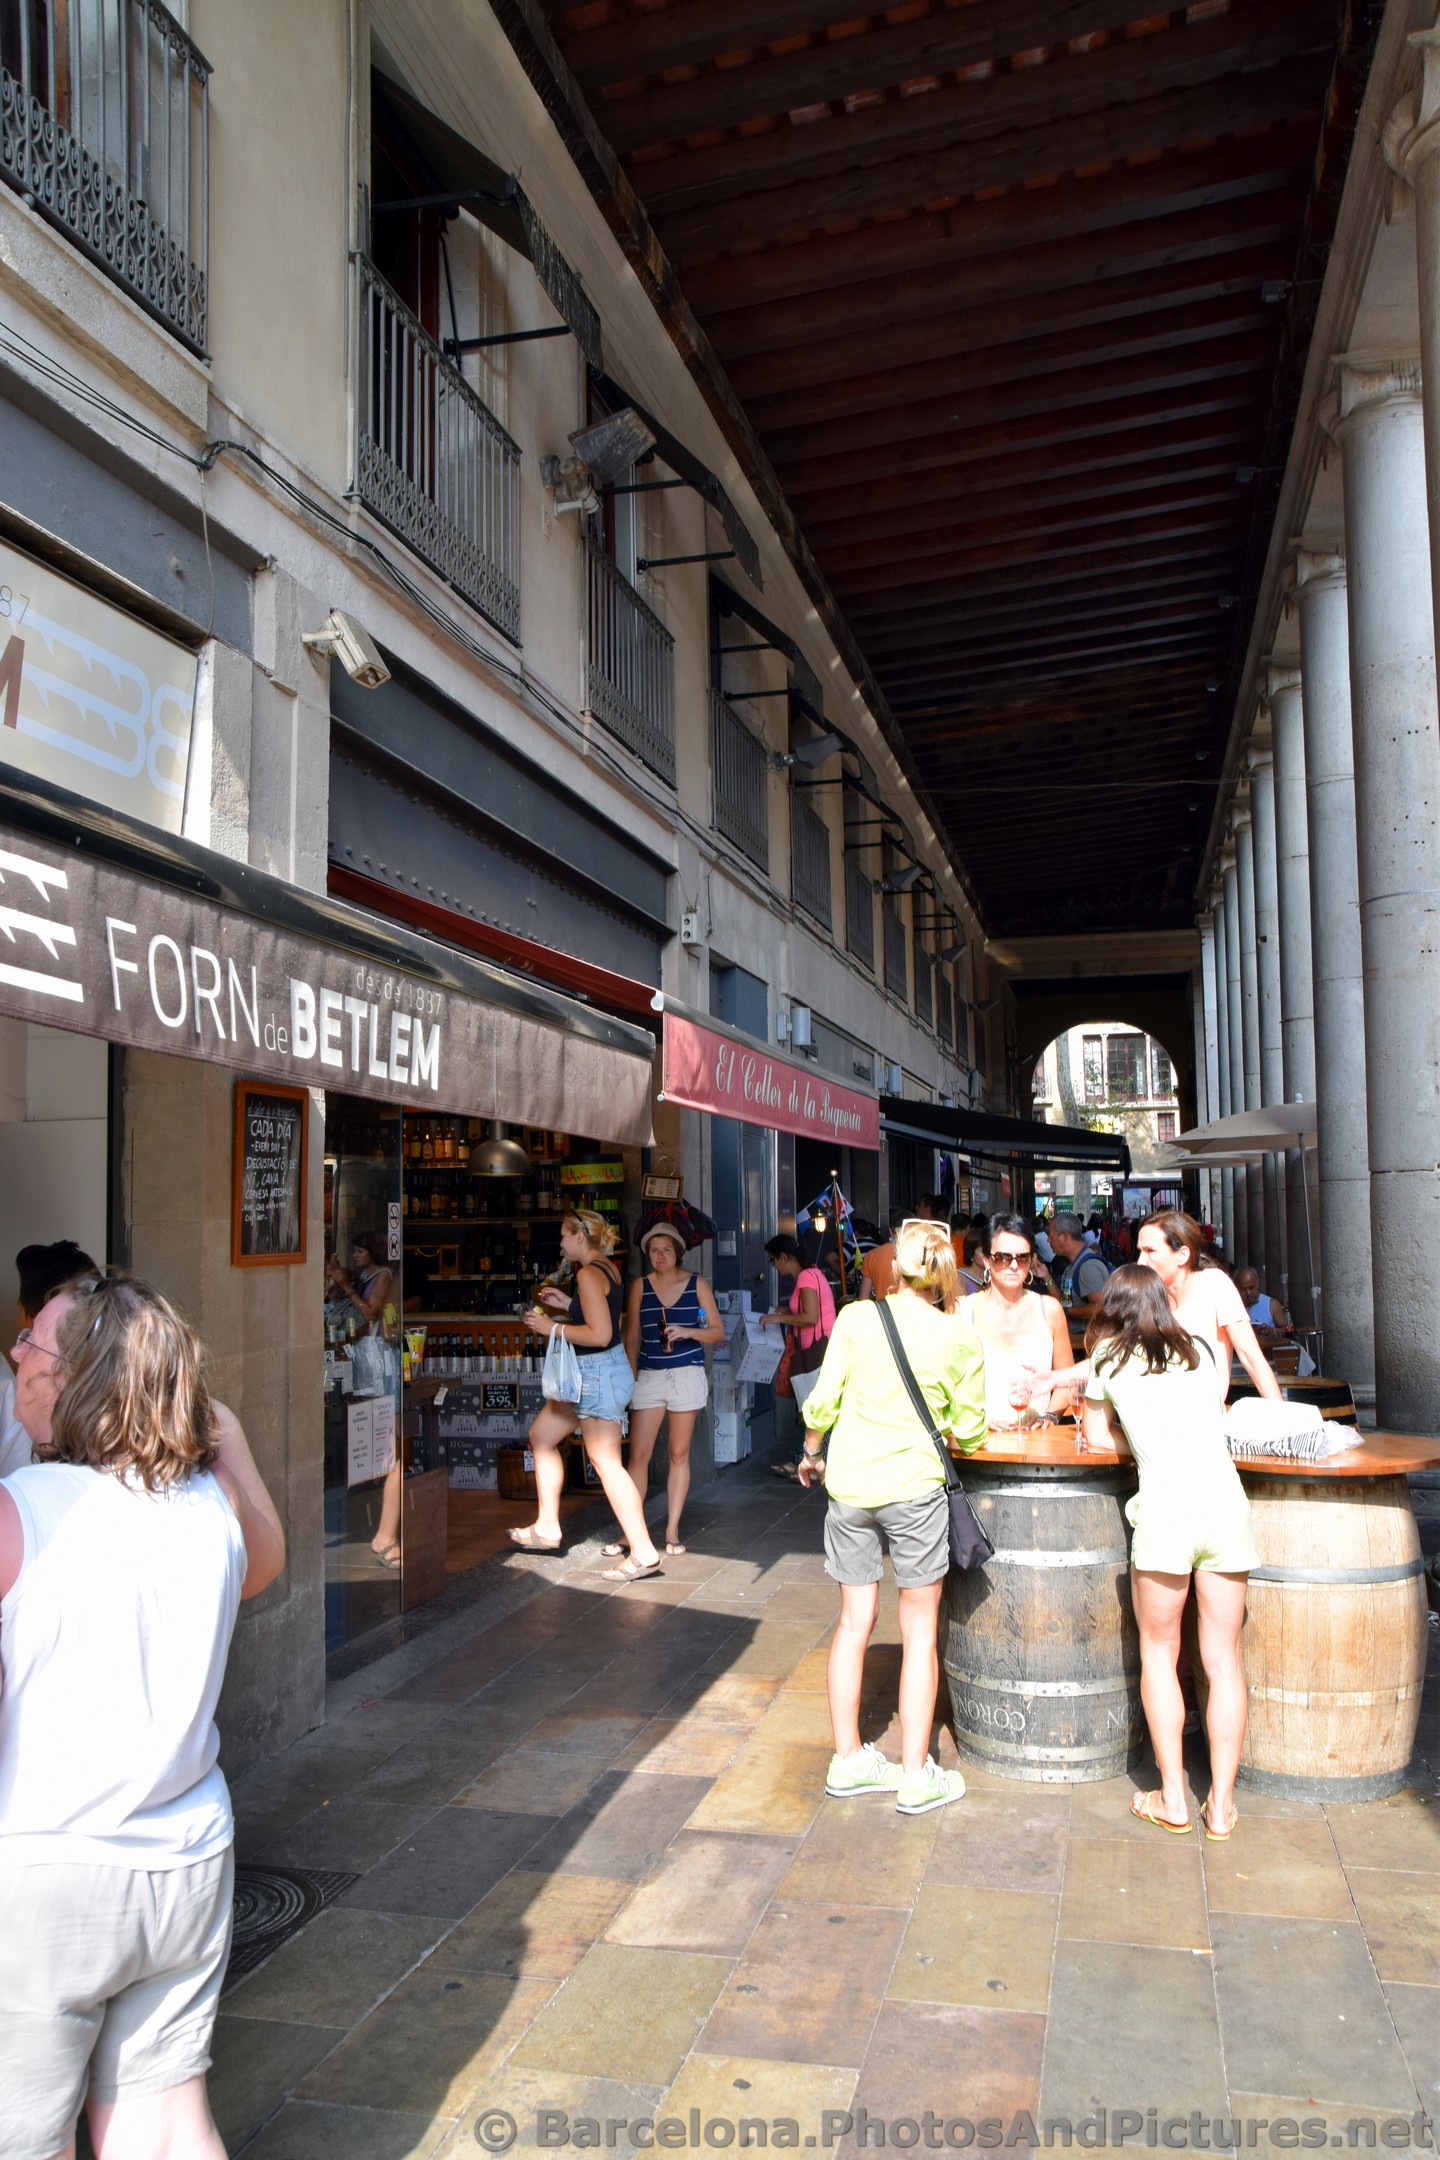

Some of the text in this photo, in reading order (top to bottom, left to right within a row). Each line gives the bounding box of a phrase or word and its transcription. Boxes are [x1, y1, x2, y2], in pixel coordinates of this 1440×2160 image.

[105, 916, 440, 1091] FORN de BETLEM
[357, 966, 441, 1015] desde 1887
[716, 1044, 735, 1095] El
[741, 1055, 783, 1109] Celler
[788, 1080, 799, 1116] de
[803, 1082, 817, 1120] la
[250, 1119, 274, 1138] CADA
[261, 1172, 280, 1186] CAVA
